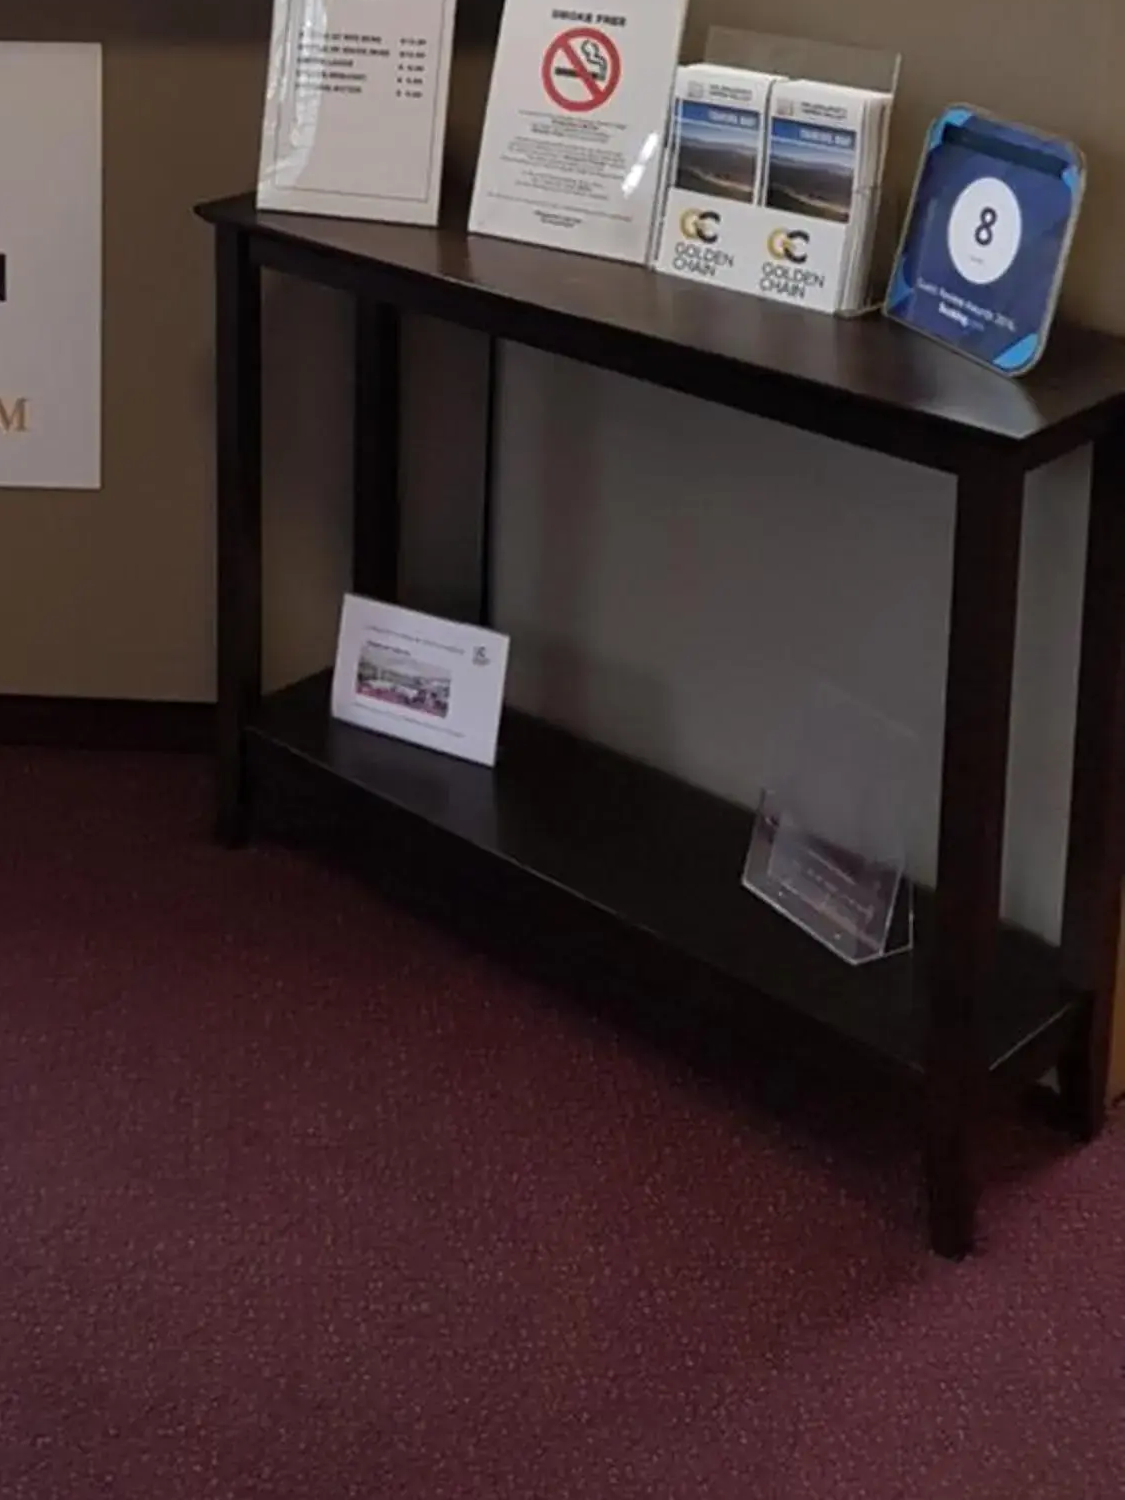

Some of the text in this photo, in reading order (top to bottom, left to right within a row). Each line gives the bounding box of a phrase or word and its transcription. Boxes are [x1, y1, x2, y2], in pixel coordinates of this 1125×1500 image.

[552, 8, 627, 28] SMOKE FREE
[974, 206, 997, 246] 8
[672, 255, 717, 277] CHAIN
[675, 241, 735, 268] GOLDEN
[759, 275, 806, 298] CHAIN
[761, 261, 825, 288] GOLDEN
